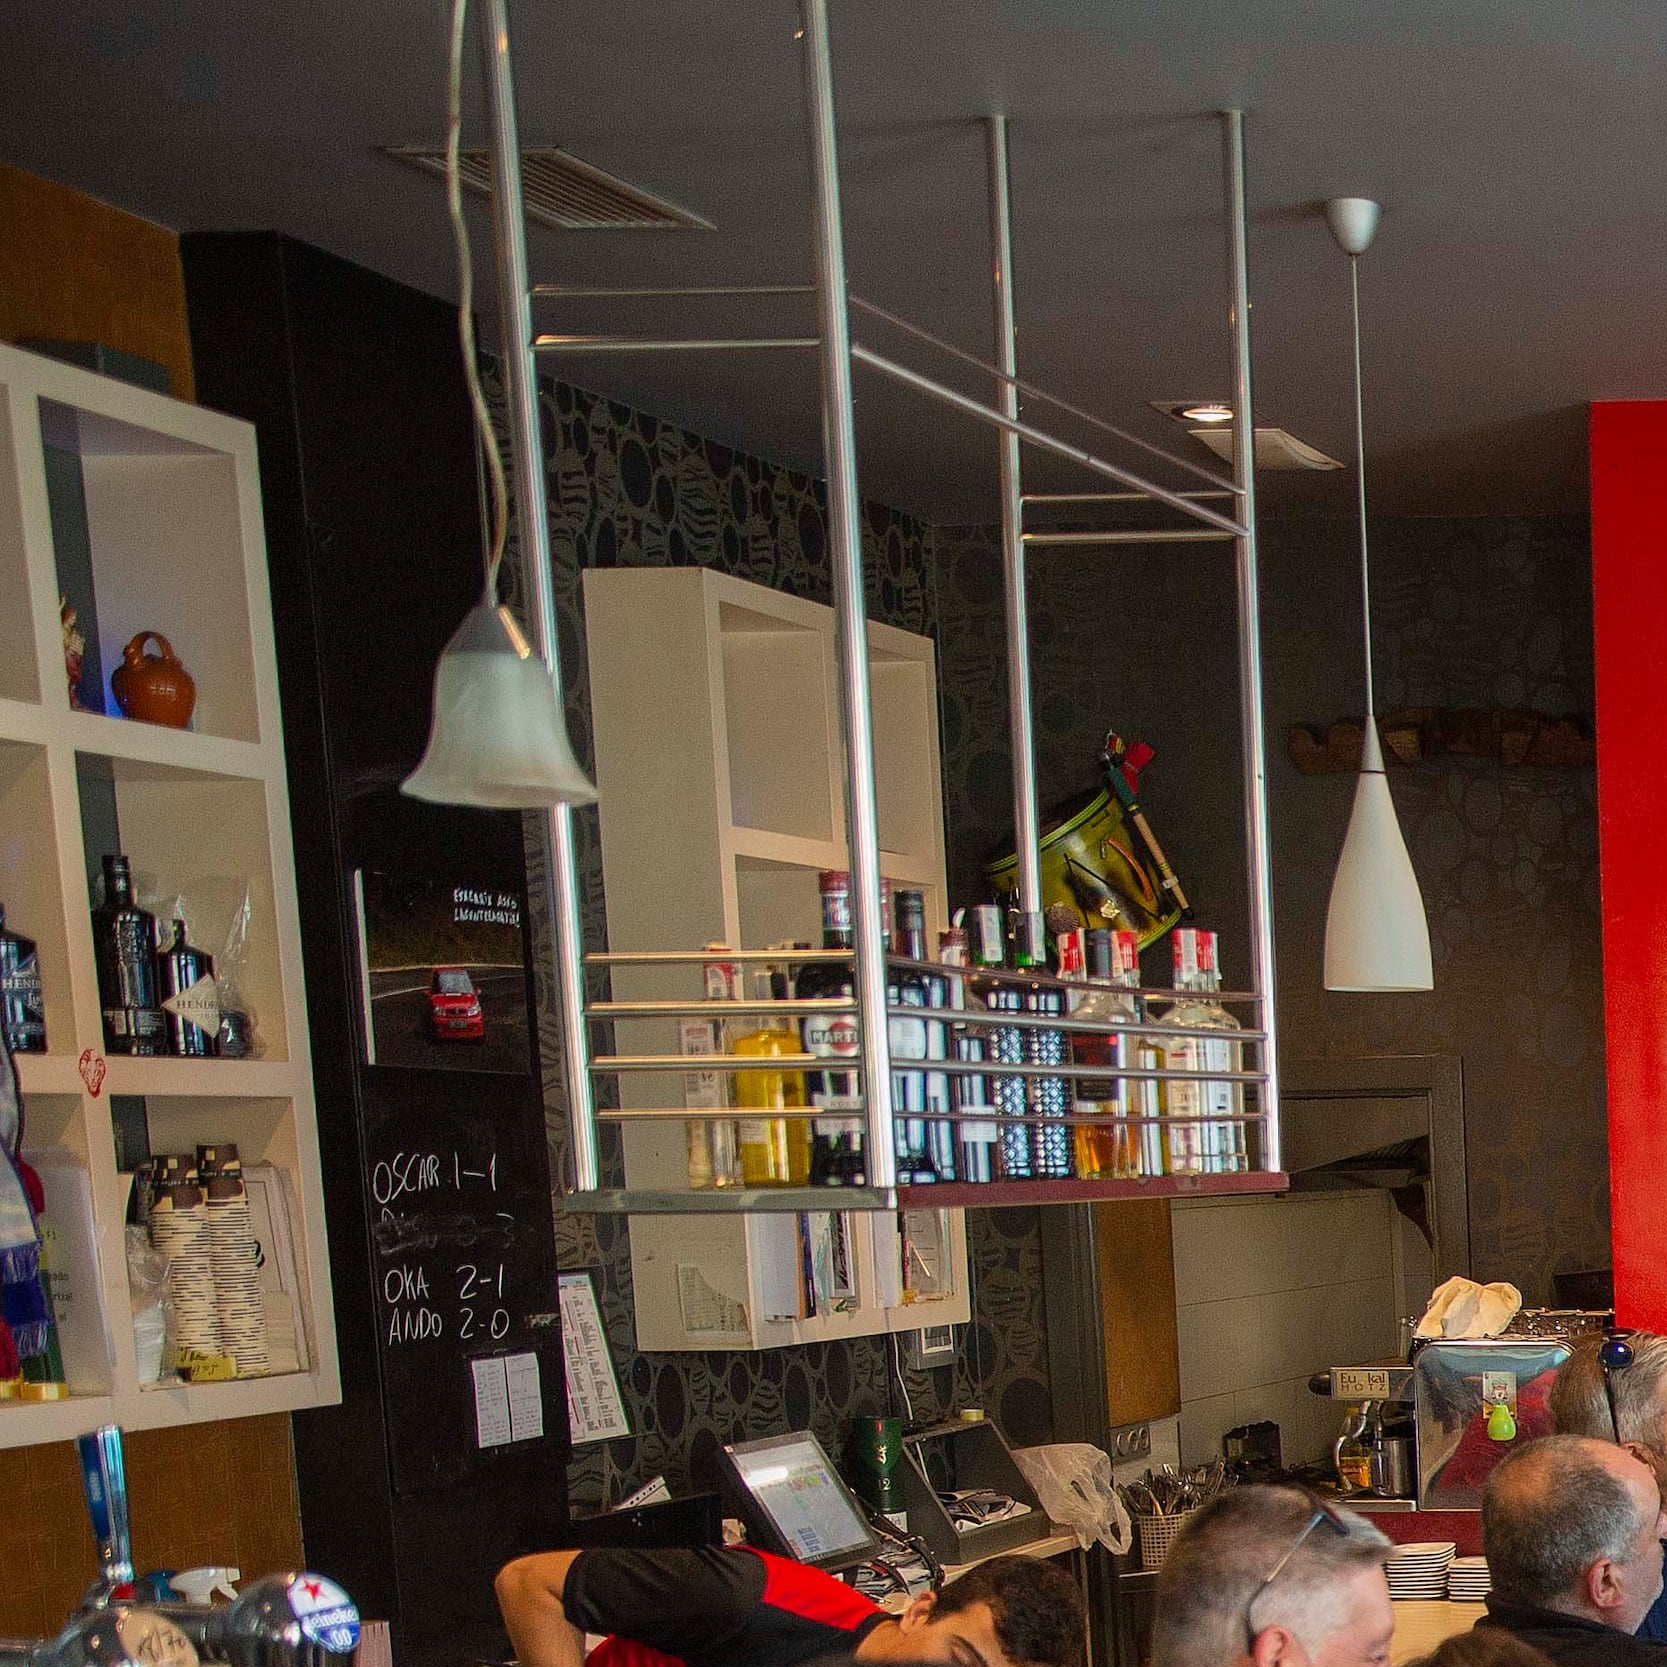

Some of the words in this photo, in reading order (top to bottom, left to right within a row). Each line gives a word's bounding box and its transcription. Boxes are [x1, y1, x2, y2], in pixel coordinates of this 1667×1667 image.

[812, 1031, 860, 1043] MARTI
[373, 1153, 439, 1204] OSCAR
[384, 1263, 430, 1303] OKA
[456, 1263, 504, 1299] 2-1
[388, 1307, 443, 1346] ANDO
[460, 1307, 510, 1339] 2-0
[304, 1607, 359, 1630] eineke
